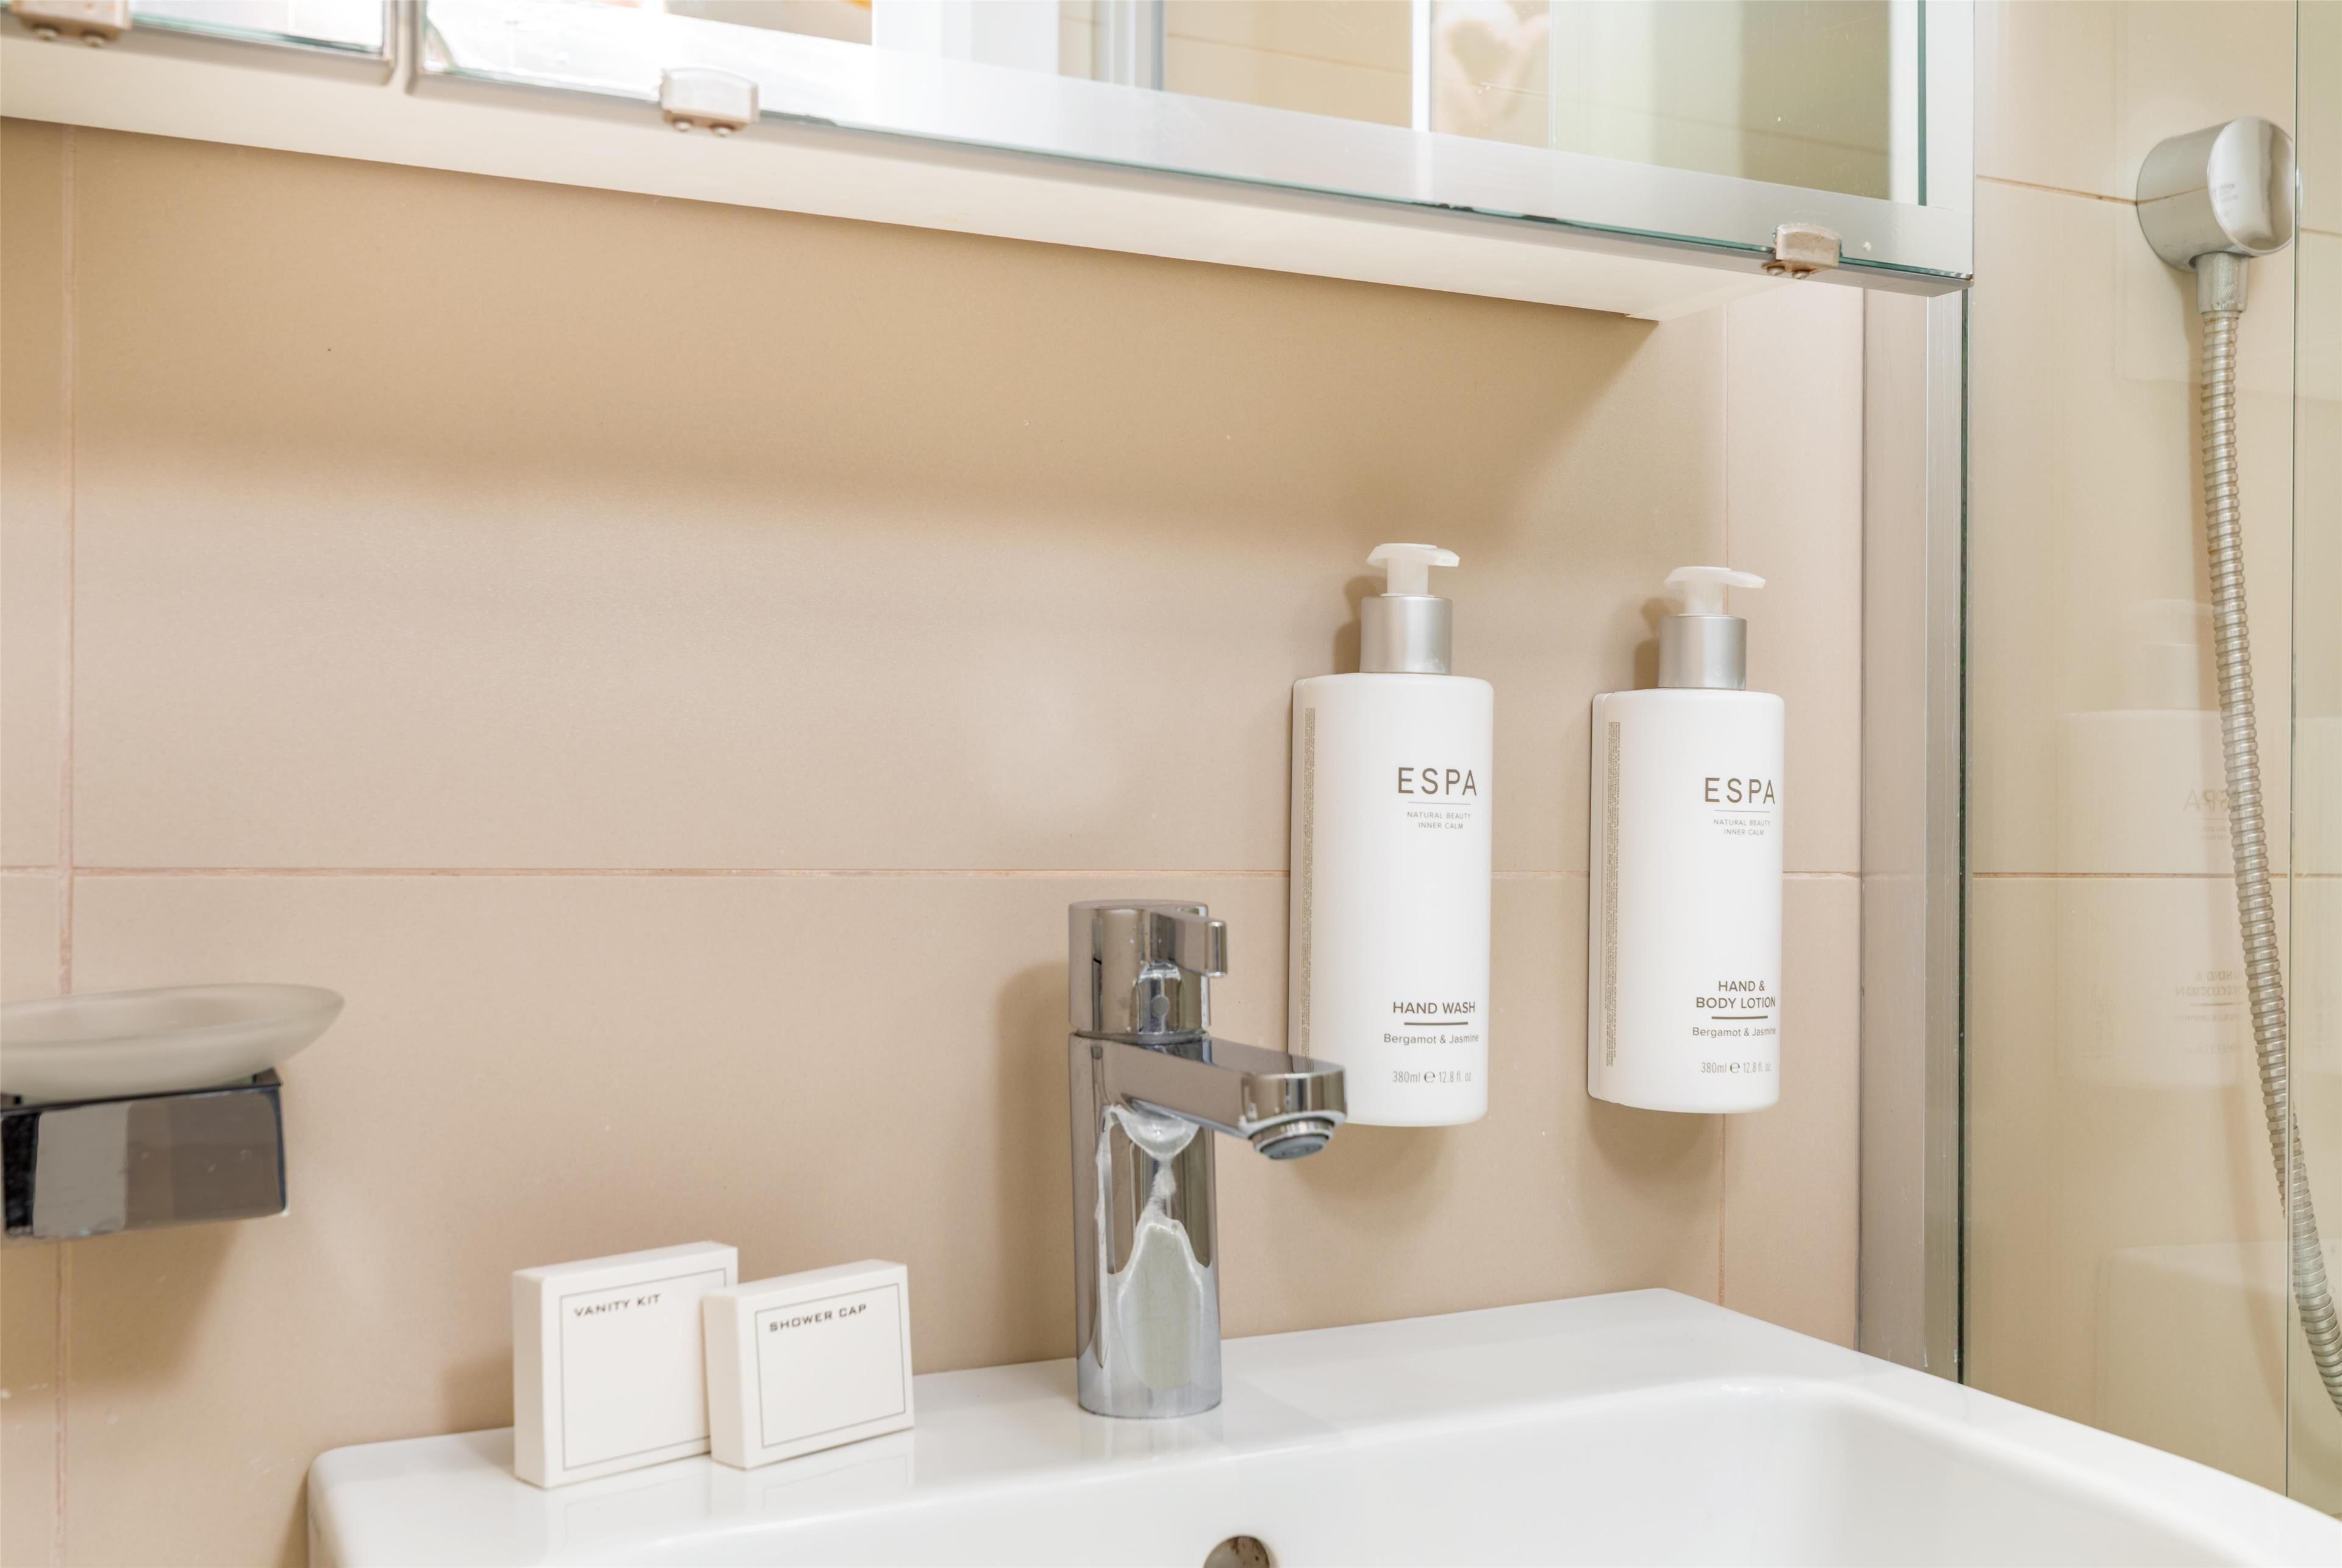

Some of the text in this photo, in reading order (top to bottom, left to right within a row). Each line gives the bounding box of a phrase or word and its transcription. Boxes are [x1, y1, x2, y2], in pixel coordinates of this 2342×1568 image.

[1398, 767, 1477, 796] ESPA
[1705, 778, 1775, 804] ESPA
[1718, 980, 1765, 992] HAND &
[1392, 1001, 1475, 1014] HAND WASH
[1696, 997, 1775, 1009] BODY LOTION
[1384, 1033, 1479, 1045] Bergamot & Jasmine
[1692, 1026, 1776, 1039] Bergamot & Jasmine
[1701, 1062, 1727, 1073] 380ml
[1742, 1062, 1756, 1073] 12.8
[1392, 1071, 1420, 1083] 380ml
[1438, 1071, 1455, 1083] 12.8
[574, 1294, 661, 1317] VANITY KIT
[769, 1303, 867, 1332] SHOWER CAP
